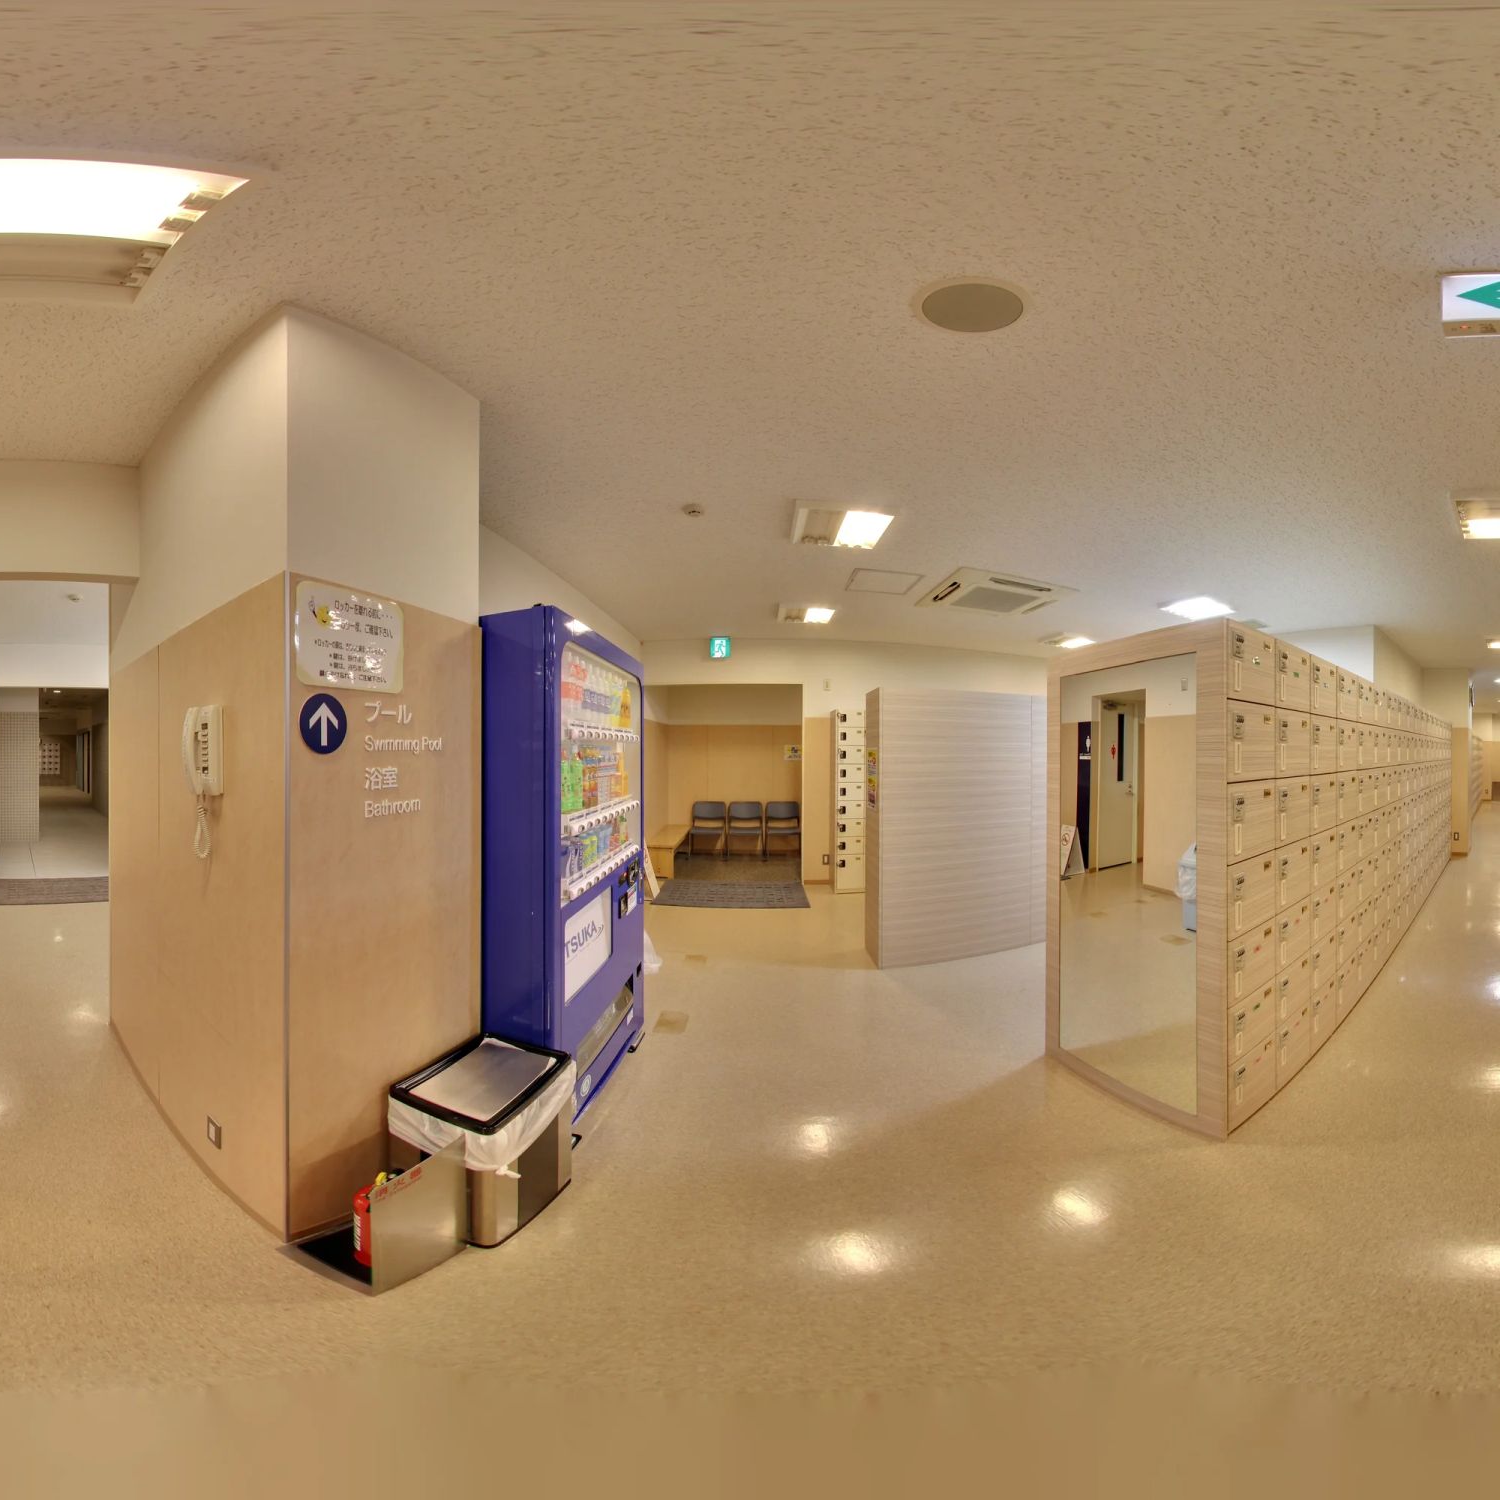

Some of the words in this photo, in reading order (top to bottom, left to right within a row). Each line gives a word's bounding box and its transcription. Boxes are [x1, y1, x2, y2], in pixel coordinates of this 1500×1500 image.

[364, 700, 413, 724] プール
[364, 735, 420, 754] Swimming
[421, 736, 442, 751] Pool
[364, 767, 398, 791] 浴室
[364, 799, 420, 818] Bathroom
